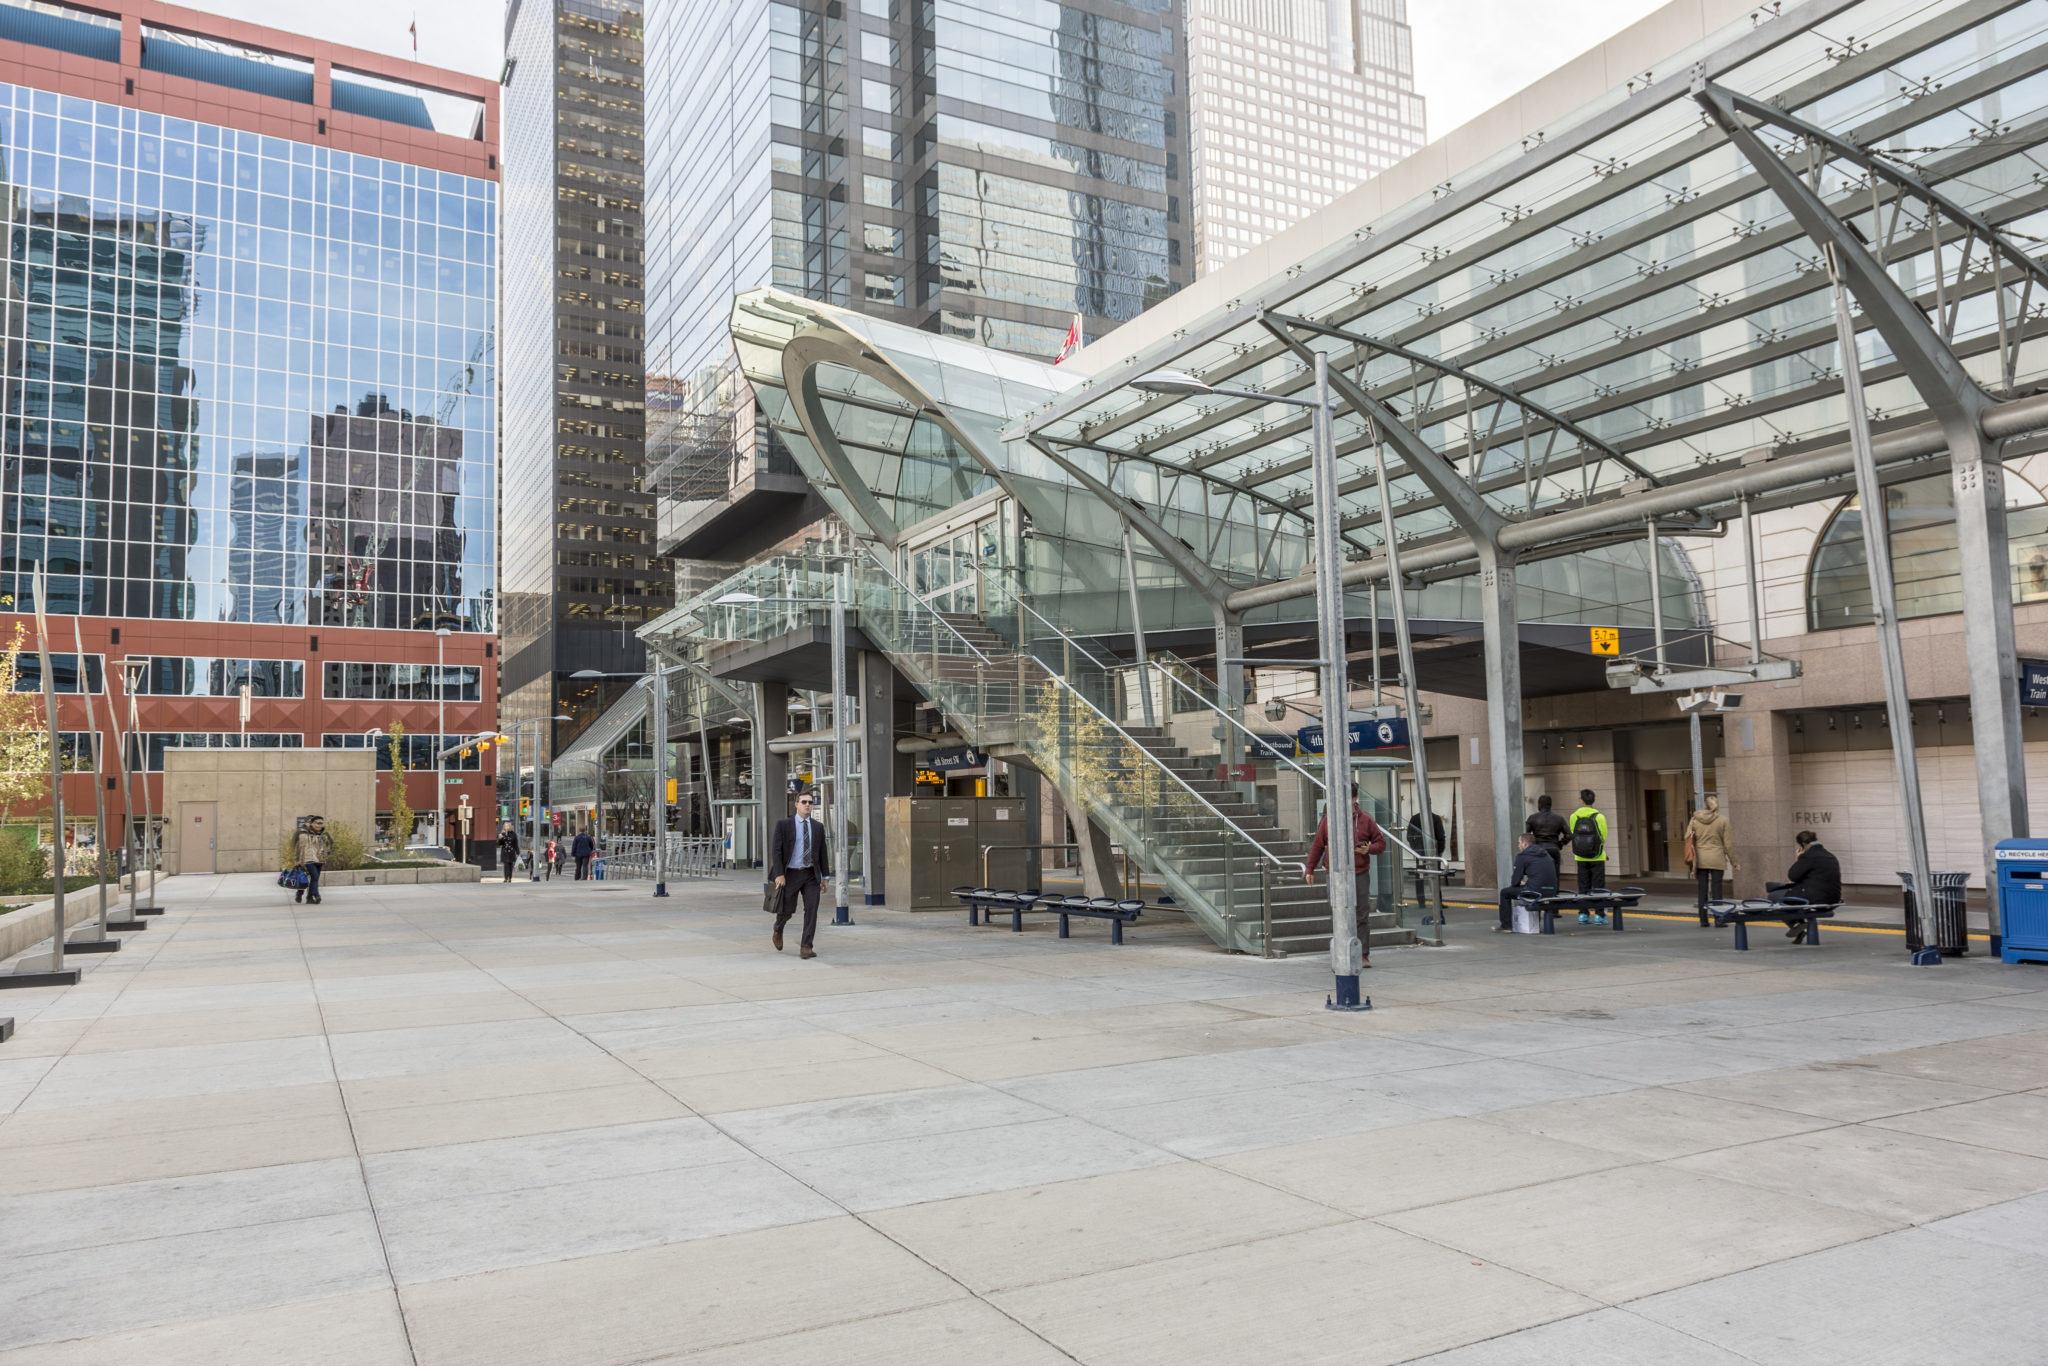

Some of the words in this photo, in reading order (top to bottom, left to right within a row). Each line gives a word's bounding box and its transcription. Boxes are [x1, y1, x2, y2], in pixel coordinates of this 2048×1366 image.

[1594, 630, 1607, 640] 5.7
[2030, 688, 2046, 699] Train
[1310, 734, 1323, 746] 4th
[1348, 732, 1360, 743] SW
[941, 757, 953, 765] Street
